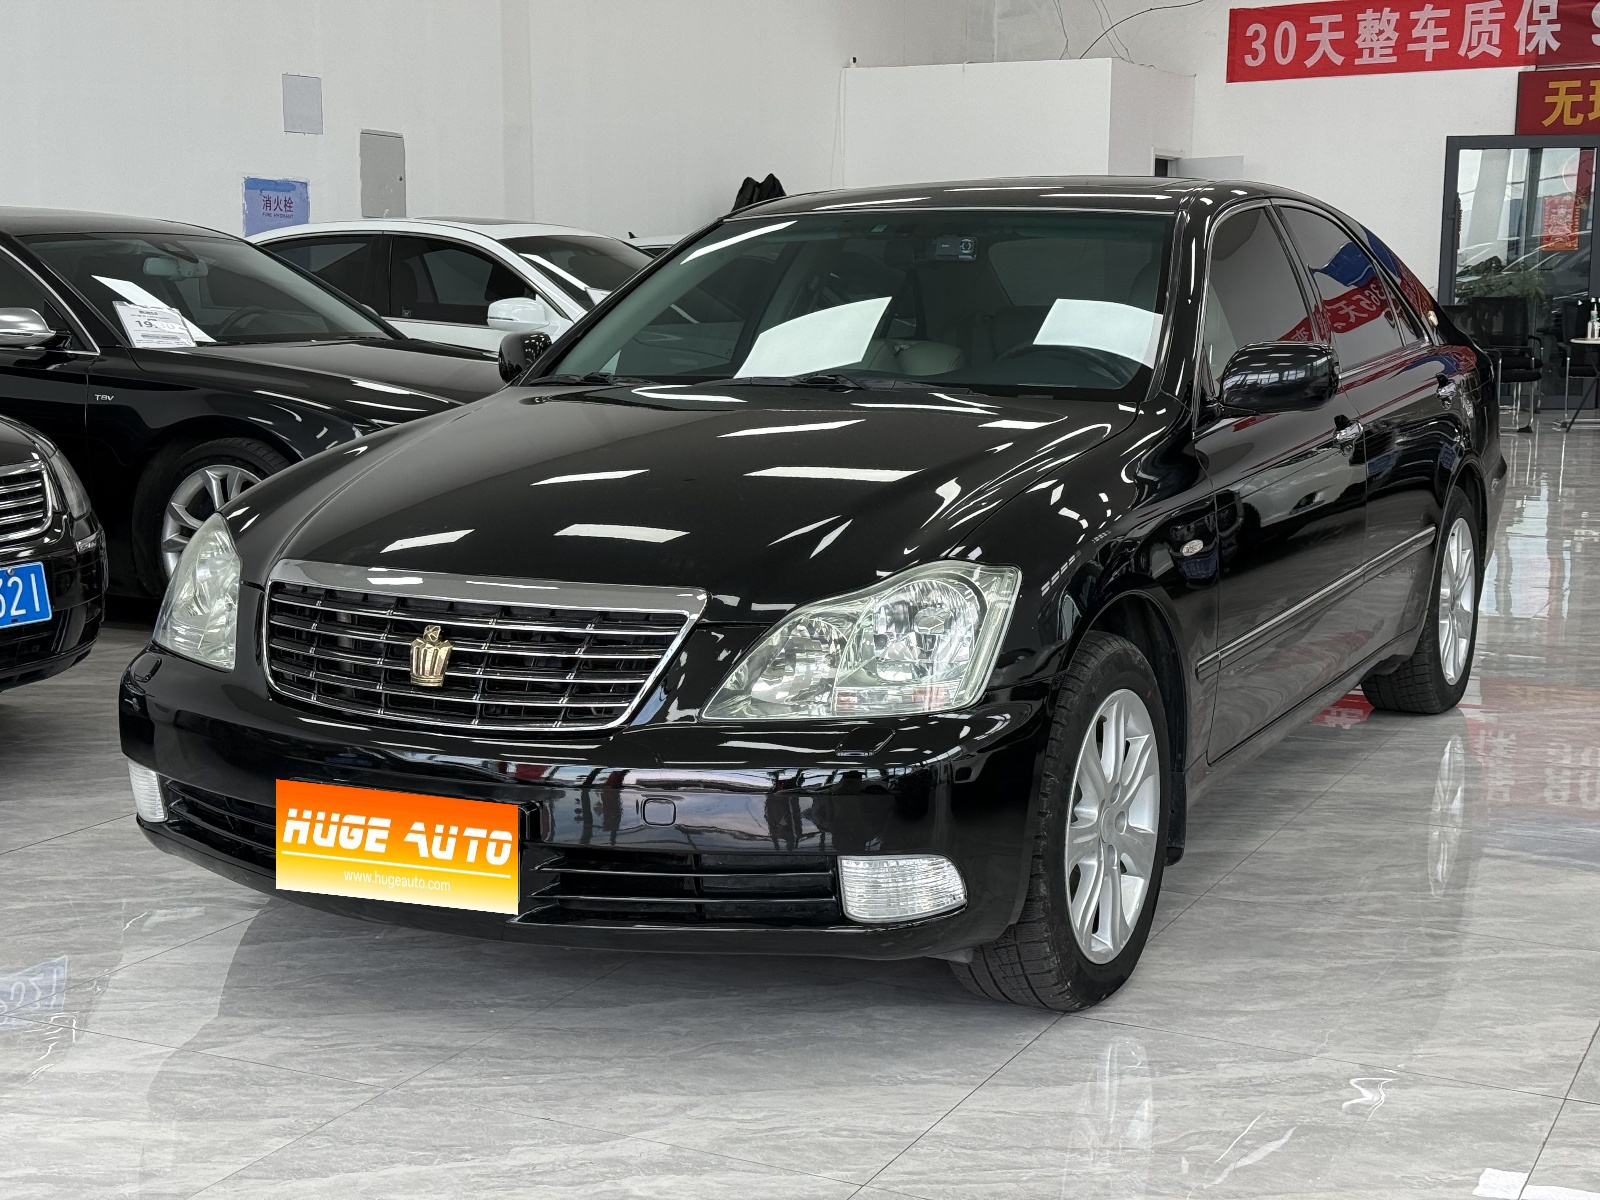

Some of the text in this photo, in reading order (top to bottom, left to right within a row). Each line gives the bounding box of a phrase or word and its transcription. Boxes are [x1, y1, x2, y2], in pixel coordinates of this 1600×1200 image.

[1243, 0, 1562, 68] 30天整车质保
[1541, 79, 1600, 127] 无
[262, 194, 294, 213] 消火栓
[0, 573, 40, 619] 21
